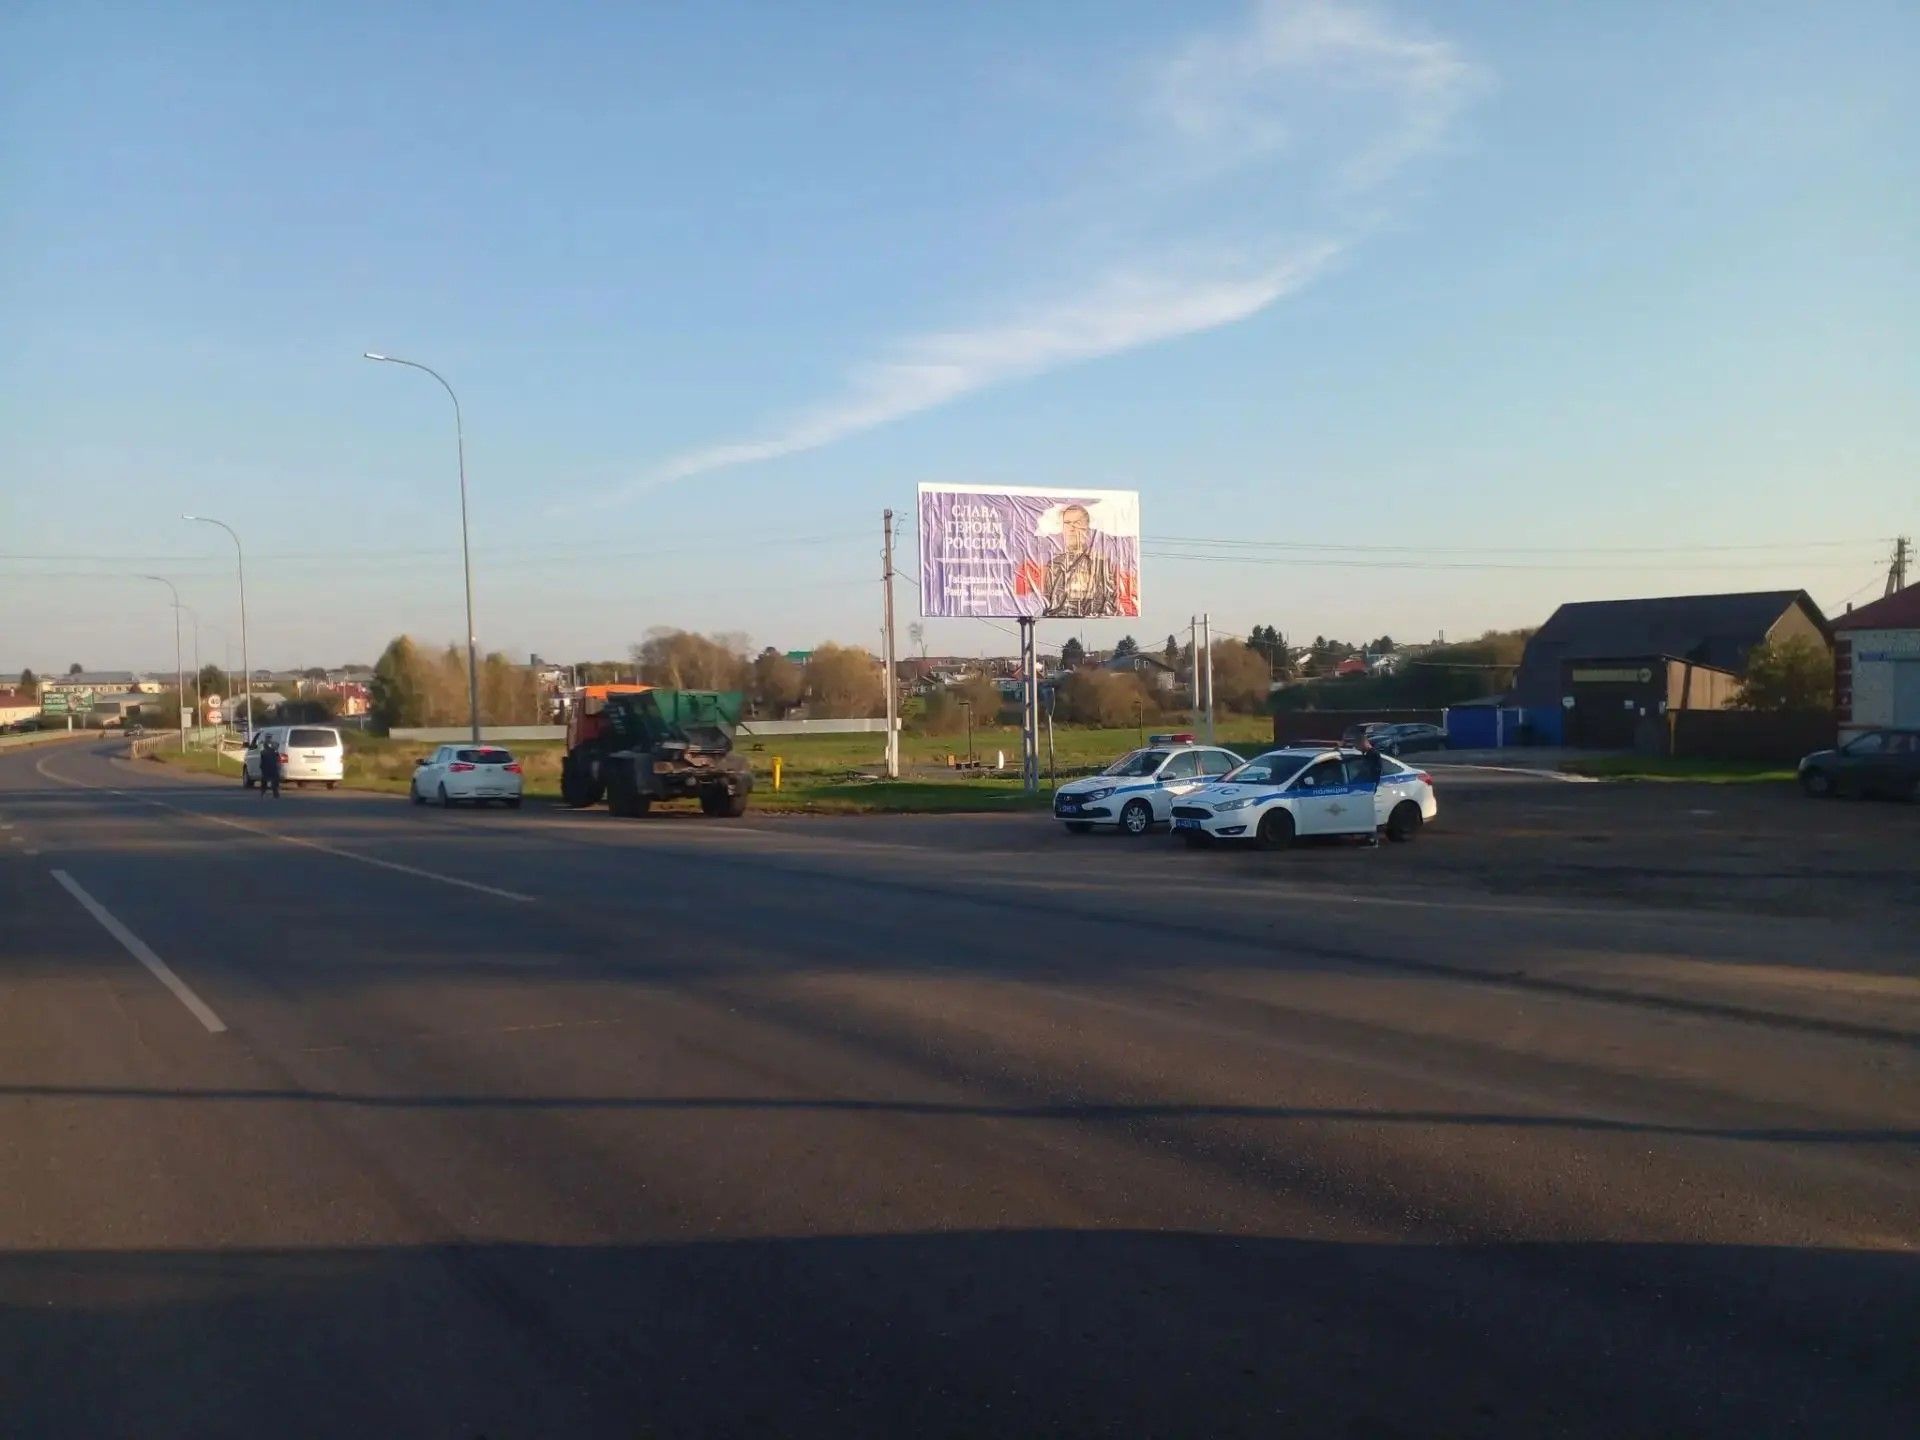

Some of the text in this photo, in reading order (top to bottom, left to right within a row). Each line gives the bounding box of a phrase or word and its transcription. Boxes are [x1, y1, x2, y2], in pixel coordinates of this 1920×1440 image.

[951, 504, 999, 519] СЛАВА
[946, 520, 1004, 534] ГЕРОЯМ
[944, 536, 1007, 550] РОССИИ
[1312, 786, 1348, 796] ПОЛИЦИЯ
